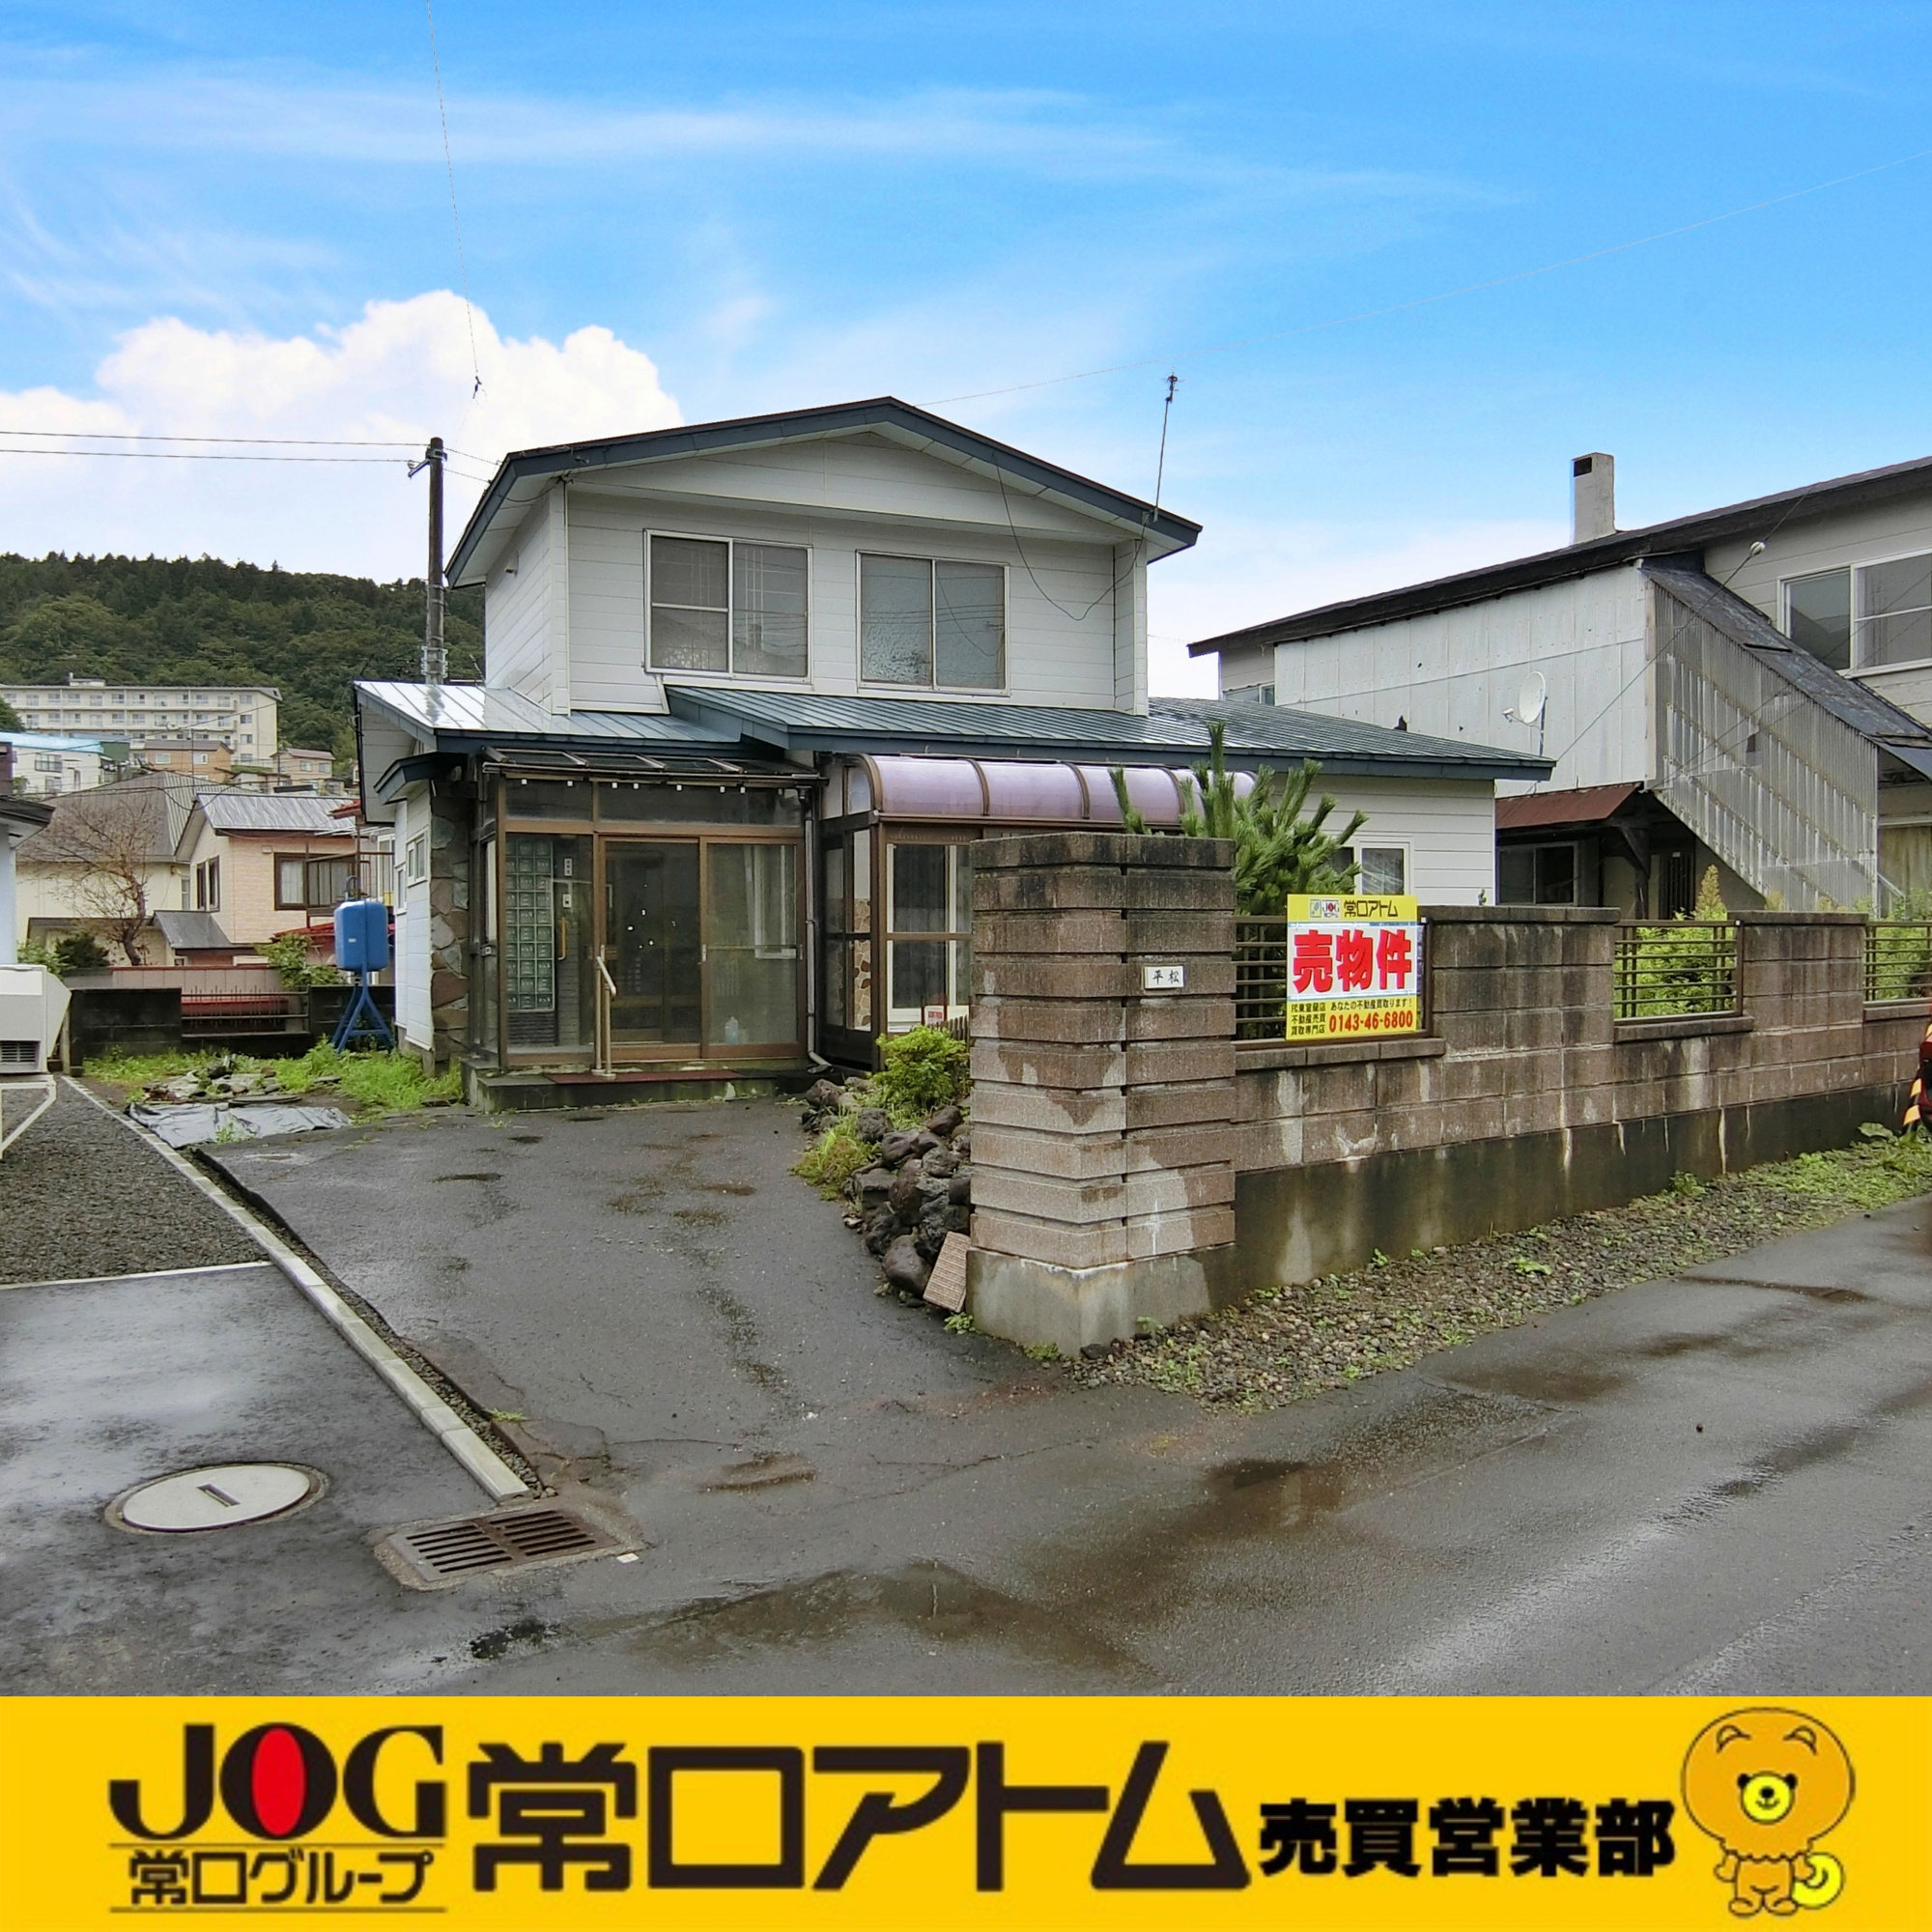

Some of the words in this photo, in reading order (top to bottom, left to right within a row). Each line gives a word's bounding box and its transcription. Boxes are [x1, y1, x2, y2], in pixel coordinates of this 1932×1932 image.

[1322, 902, 1340, 913] JOG
[1344, 899, 1399, 918] 常口アトム
[1293, 929, 1412, 993] 売物件
[1328, 1009, 1413, 1033] 0143-46-6800
